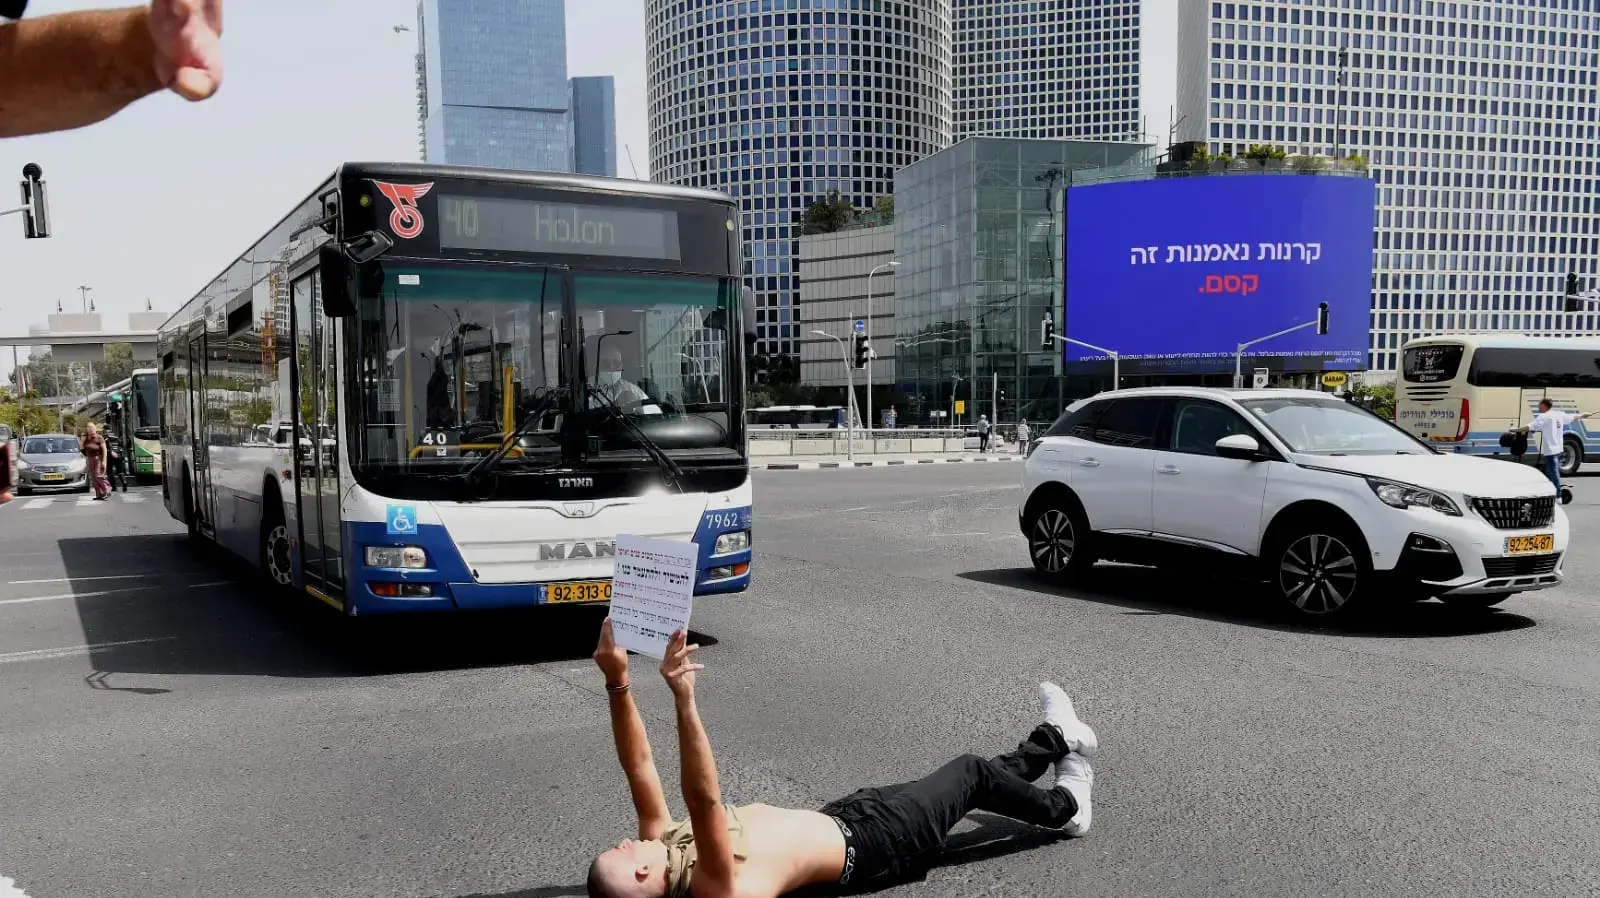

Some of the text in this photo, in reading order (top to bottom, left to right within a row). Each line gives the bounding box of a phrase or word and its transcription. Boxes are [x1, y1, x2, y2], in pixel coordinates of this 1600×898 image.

[445, 199, 479, 238] 40
[1130, 242, 1321, 265] קרנות נאמנות זה
[1198, 274, 1259, 296] קסם.
[422, 432, 447, 445] 40
[558, 477, 594, 488] הארגז
[706, 512, 738, 529] 7962
[540, 541, 616, 561] MAN
